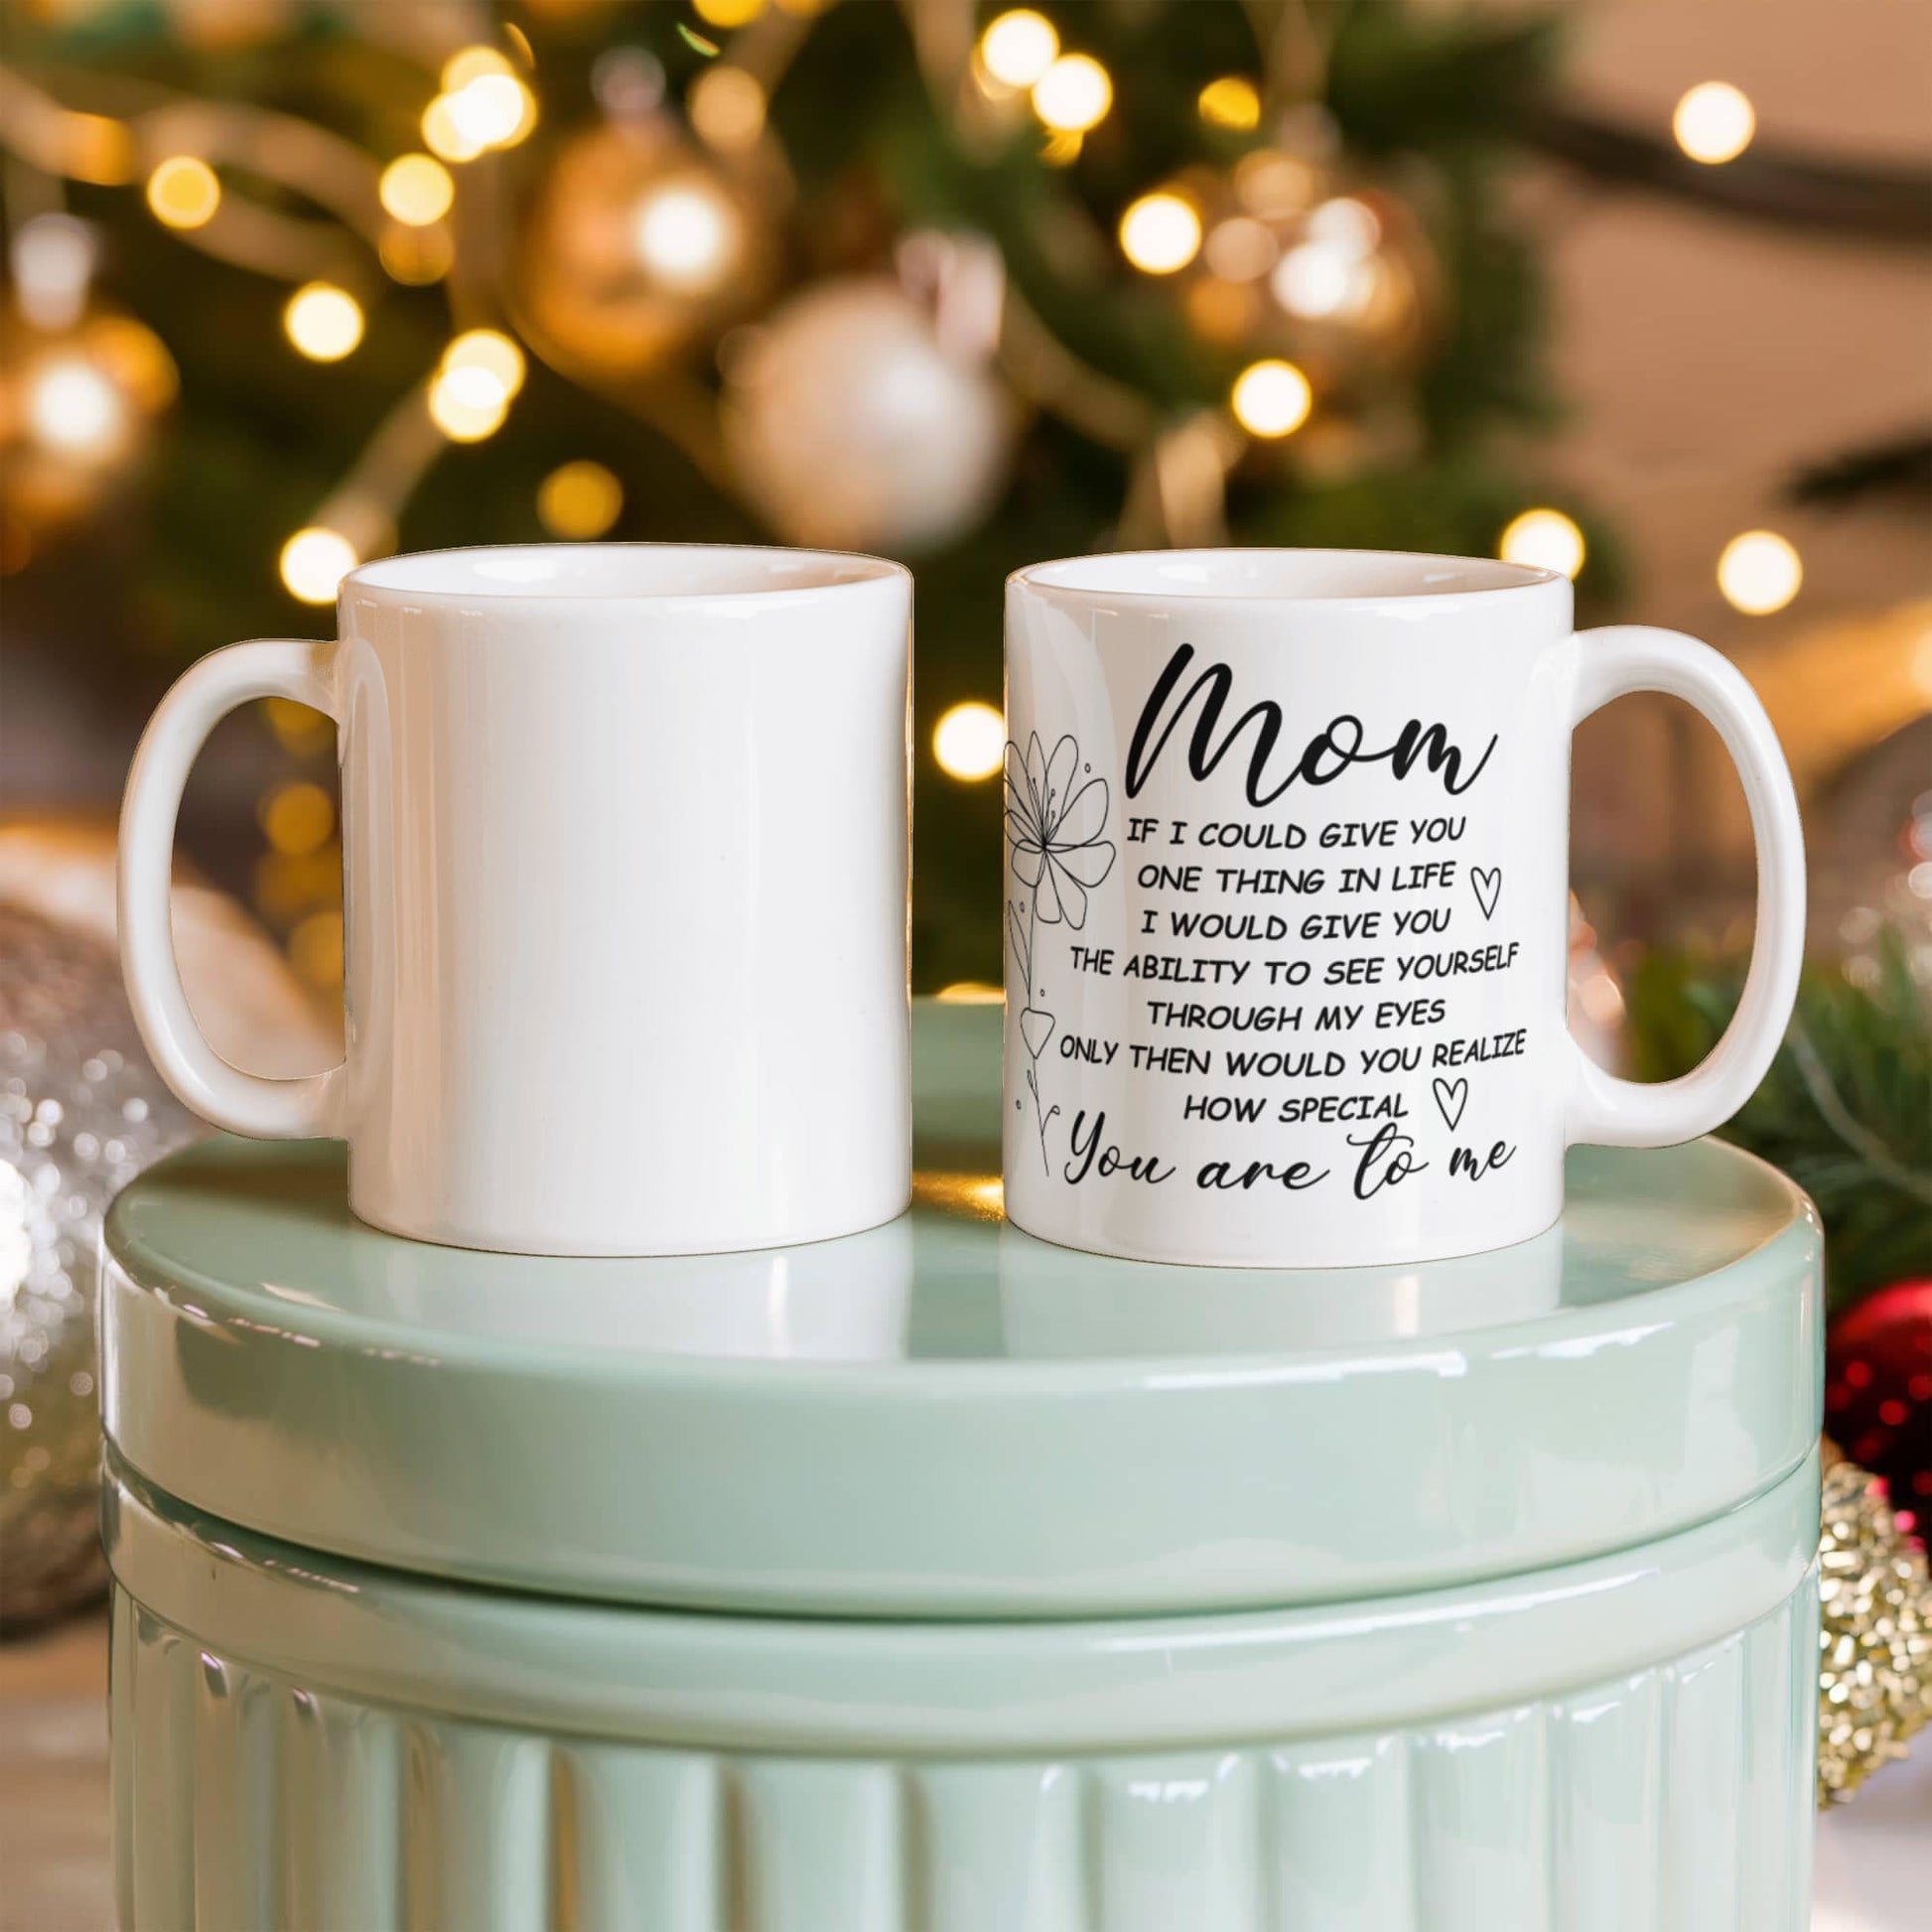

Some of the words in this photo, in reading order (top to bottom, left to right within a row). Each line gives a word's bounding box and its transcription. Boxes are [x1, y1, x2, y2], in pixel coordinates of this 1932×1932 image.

[1124, 642, 1498, 808] Mom
[1126, 817, 1160, 844] IF
[1169, 820, 1188, 845] I
[1197, 822, 1307, 850] COULD
[1318, 820, 1399, 849] GIVE
[1410, 816, 1466, 844] YOU
[1137, 864, 1203, 893] ONE
[1215, 869, 1325, 895] THING
[1338, 867, 1381, 894] IN
[1391, 861, 1456, 892] LIFE
[1141, 909, 1159, 934] I
[1171, 911, 1288, 941] WOULD
[1300, 913, 1382, 940] GIVE
[1393, 907, 1451, 936] YOU
[1069, 945, 1115, 976] THE
[1122, 954, 1251, 986] ABILITY
[1264, 961, 1311, 986] TO
[1323, 957, 1385, 985] SEE
[1397, 940, 1519, 981] YOURSELF
[1147, 1001, 1304, 1032] THROUGH
[1314, 1005, 1364, 1032] MY
[1375, 999, 1446, 1029] EYES
[1059, 1035, 1120, 1065] ONLY
[1129, 1044, 1211, 1075] THEN
[1226, 1050, 1346, 1077] WOULD
[1360, 1046, 1422, 1075] YOU
[1432, 1028, 1527, 1068] REALIZE
[1183, 1094, 1267, 1123] HOW
[1278, 1093, 1409, 1123] SPECIAL
[1064, 1111, 1175, 1184] You
[1197, 1162, 1329, 1189] are
[1347, 1123, 1429, 1199] to
[1449, 1140, 1516, 1181] me
